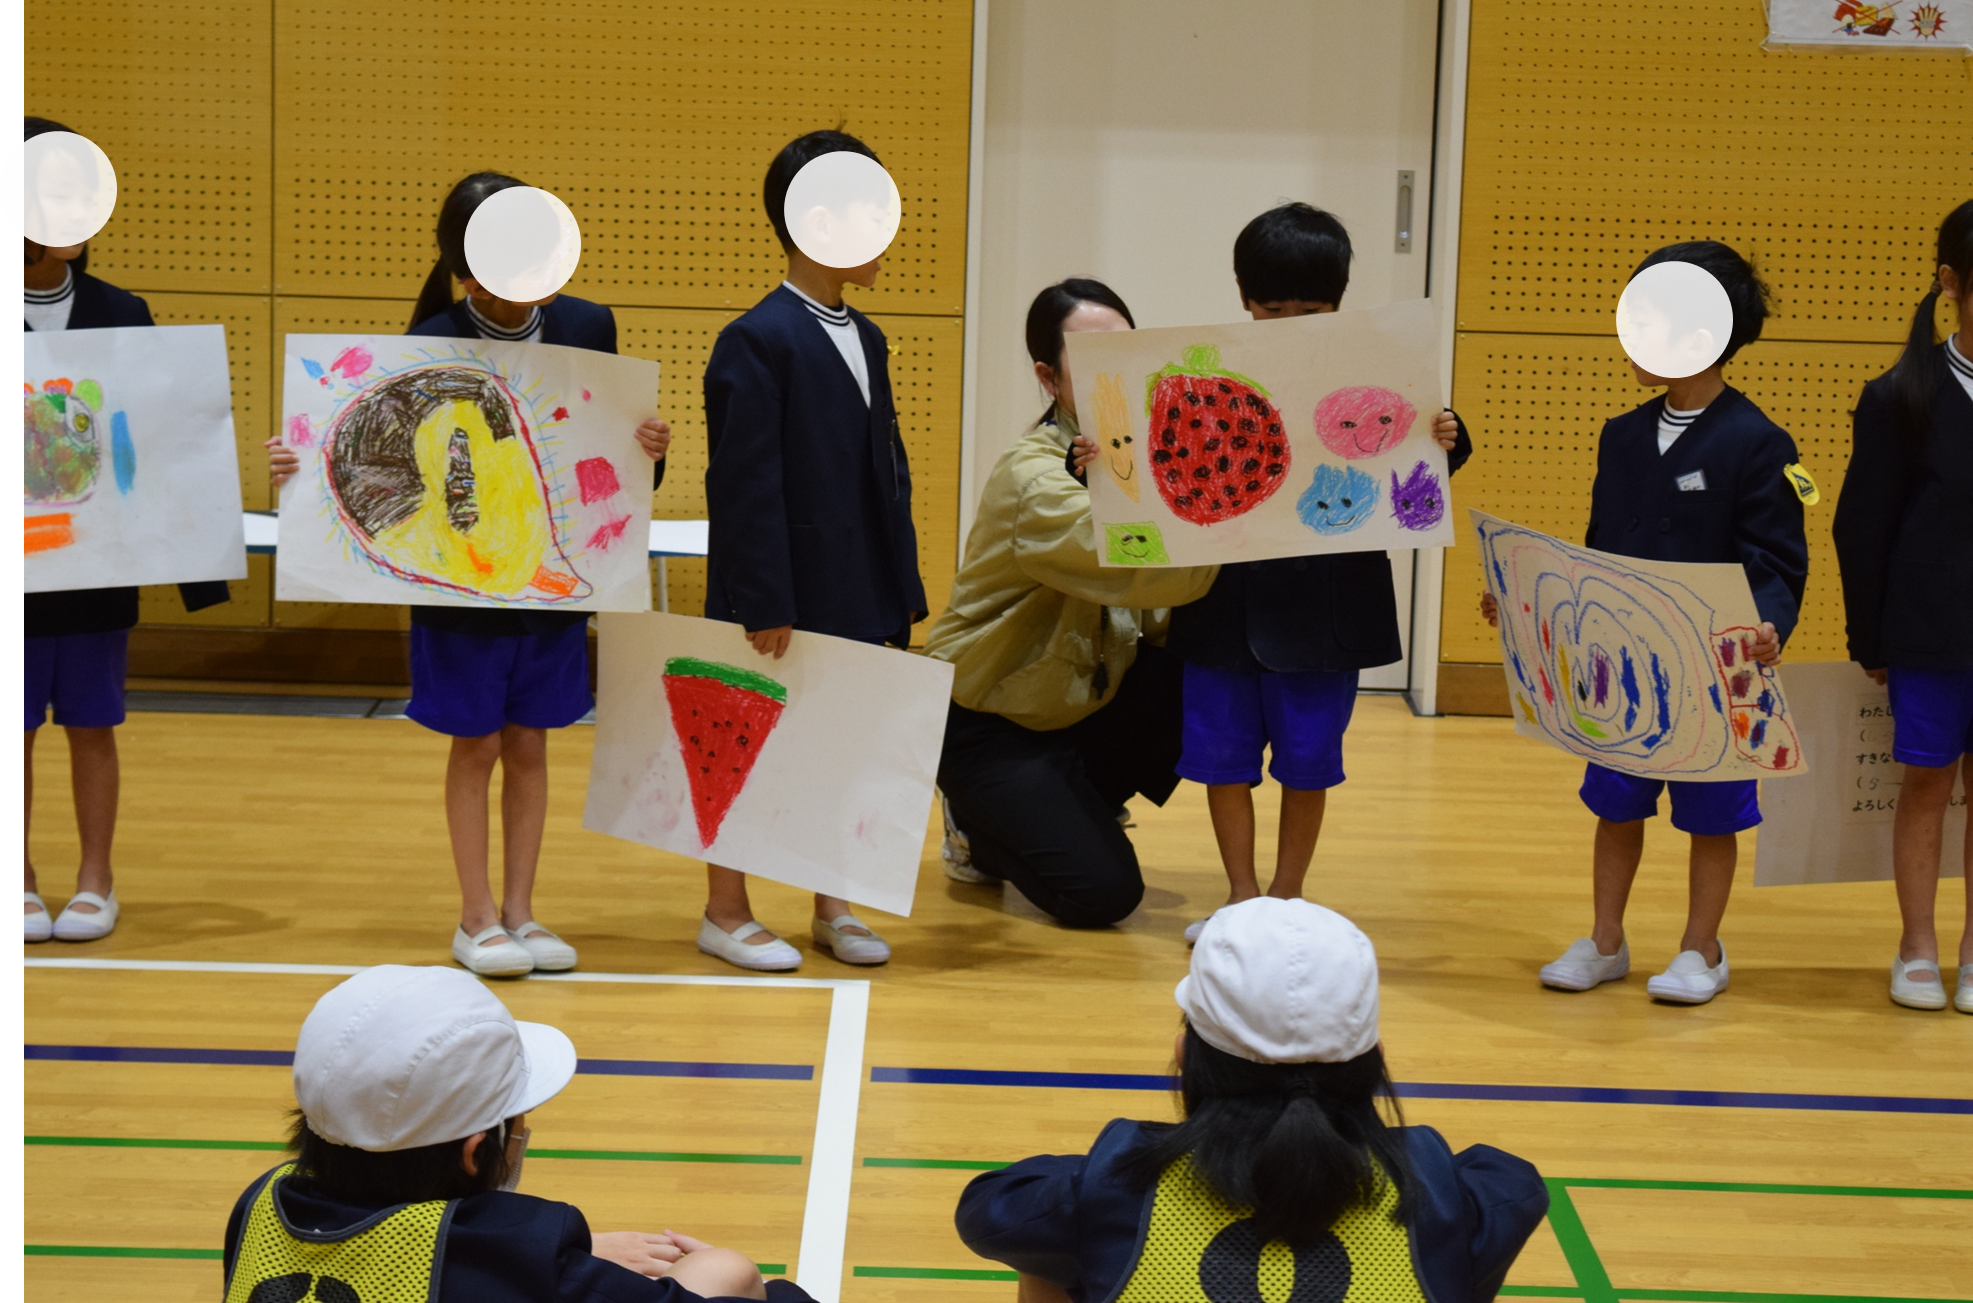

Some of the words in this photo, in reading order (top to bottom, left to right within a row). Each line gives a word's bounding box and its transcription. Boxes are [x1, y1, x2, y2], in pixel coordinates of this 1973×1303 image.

[1856, 752, 1900, 765] すきな
[1852, 798, 1895, 812] よろしく
